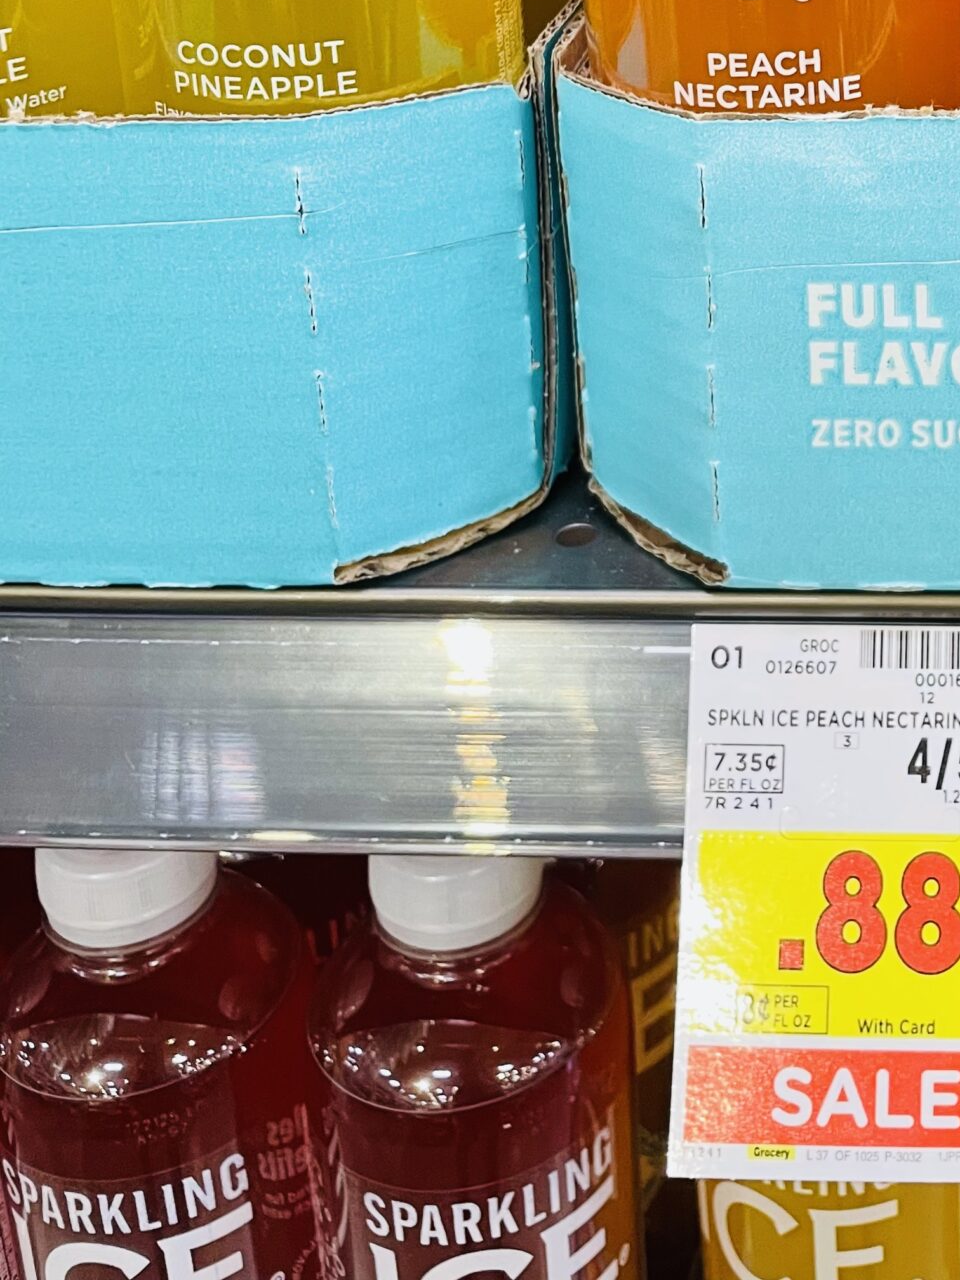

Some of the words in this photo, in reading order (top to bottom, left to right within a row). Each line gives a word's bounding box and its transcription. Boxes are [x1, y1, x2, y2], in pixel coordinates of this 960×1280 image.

[176, 40, 345, 69] COCONUT
[706, 48, 822, 78] PEACH
[174, 69, 359, 102] PINEAPPLE
[672, 73, 863, 110] NECTARINE
[6, 86, 67, 113] Water
[805, 280, 943, 331] FULL
[811, 418, 901, 449] ZERO
[800, 639, 840, 653] GROC
[766, 661, 837, 675] 0126607
[920, 692, 935, 705] 12
[708, 709, 763, 727] SPKLN
[771, 710, 799, 727] ICE
[806, 711, 865, 729] PEACH
[843, 735, 852, 748] 3
[714, 752, 777, 772] 7.35¢
[709, 778, 735, 790] PER
[740, 779, 755, 791] FL
[761, 779, 781, 791] OZ
[774, 995, 799, 1008] PER
[793, 1015, 811, 1028] OZ
[857, 1018, 894, 1035] With
[899, 1019, 935, 1035] Card
[753, 1147, 790, 1160] Grocery
[834, 1151, 850, 1161] OF
[855, 1151, 880, 1162] 1025
[363, 1127, 612, 1246] SPARKLING
[2, 1158, 250, 1236] SPARKLING
